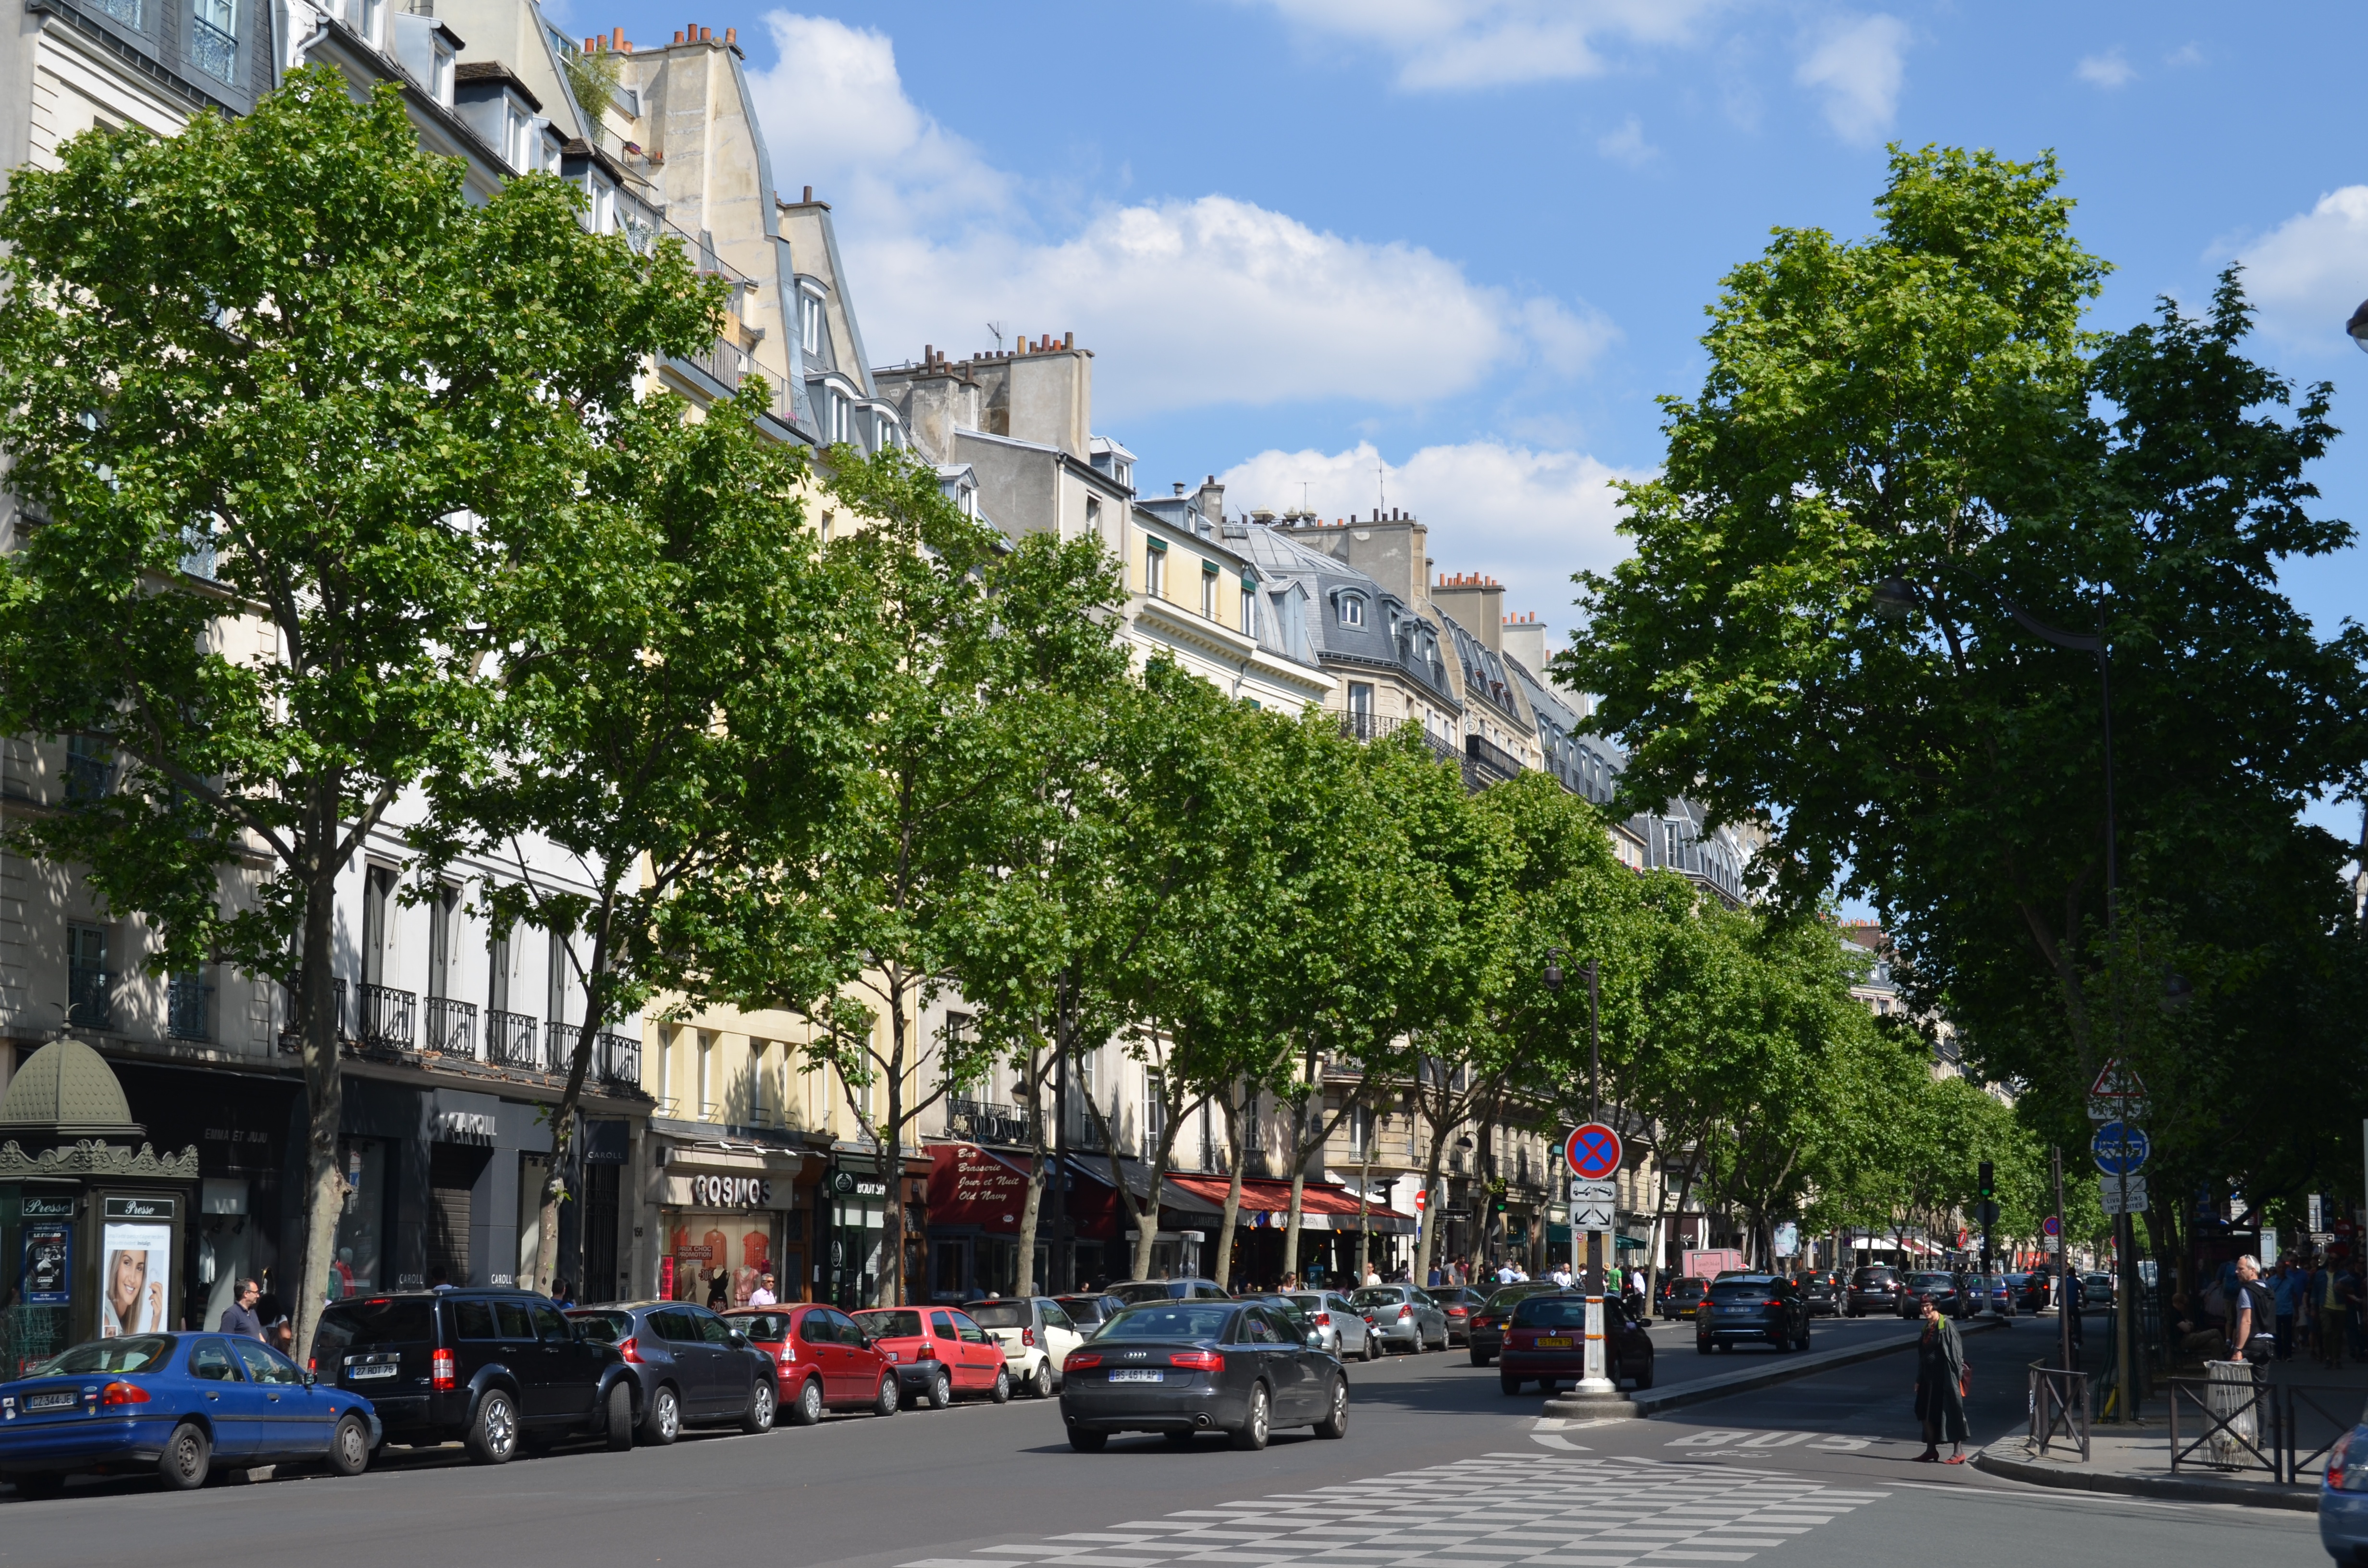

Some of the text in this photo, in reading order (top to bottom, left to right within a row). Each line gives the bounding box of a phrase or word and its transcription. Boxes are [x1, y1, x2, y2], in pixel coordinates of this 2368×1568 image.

[447, 1112, 497, 1136] CAROLL
[974, 1115, 997, 1138] OLD
[1000, 1118, 1028, 1139] NAVY
[205, 1128, 268, 1143] EMMA ET JUJU
[958, 1148, 976, 1158] Bar
[958, 1163, 1001, 1172] Brasserie
[958, 1176, 981, 1189] Jour
[996, 1176, 1019, 1185] Nuit
[692, 1175, 772, 1204] COSMOS
[857, 1183, 886, 1195] BODY SH
[959, 1190, 1007, 1201] Old Navy
[25, 1199, 70, 1213] Presse
[125, 1200, 155, 1214] Presse
[2108, 1202, 2142, 1211] INTDITES
[1195, 1215, 1219, 1227] LAMARTHE
[634, 1227, 643, 1237] 156
[399, 1274, 423, 1284] CAROLL
[491, 1274, 512, 1284] CAROLL
[699, 1270, 713, 1280] -30%
[712, 1301, 726, 1312] -20%
[1115, 1370, 1157, 1379] BS-461-AP
[33, 1394, 72, 1407] CZ-344-JE
